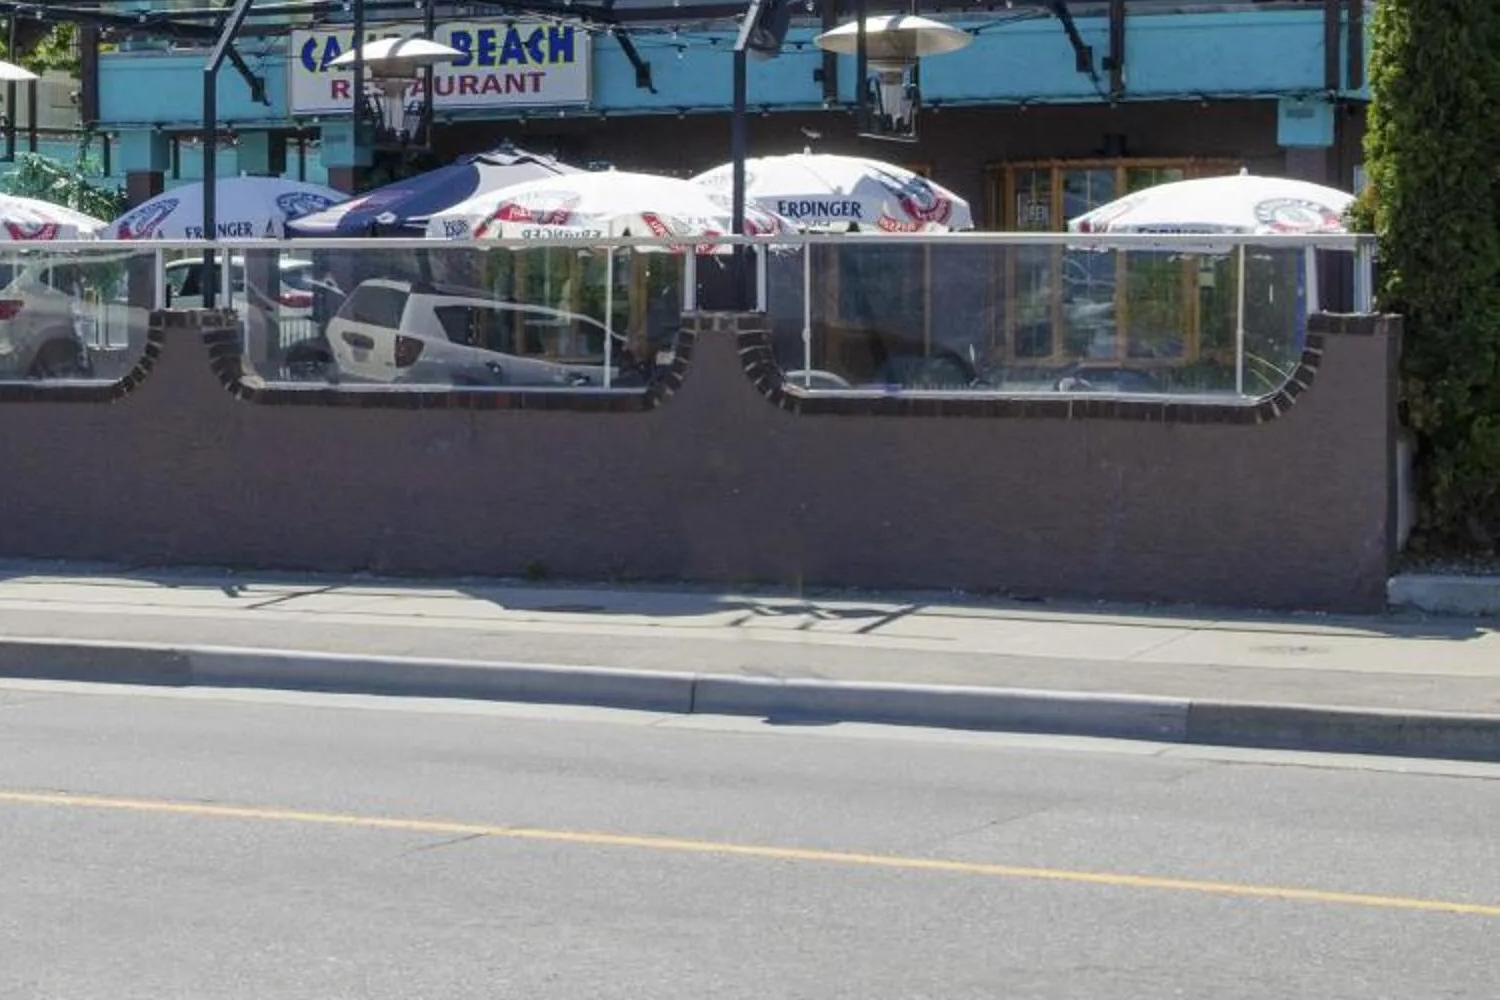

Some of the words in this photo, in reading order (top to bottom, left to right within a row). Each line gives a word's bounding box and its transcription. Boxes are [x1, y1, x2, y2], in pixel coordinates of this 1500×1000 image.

[450, 25, 575, 67] BEACH
[331, 71, 546, 99] RAURANT
[778, 200, 862, 220] ERDINGER
[185, 221, 253, 239] ERNGER
